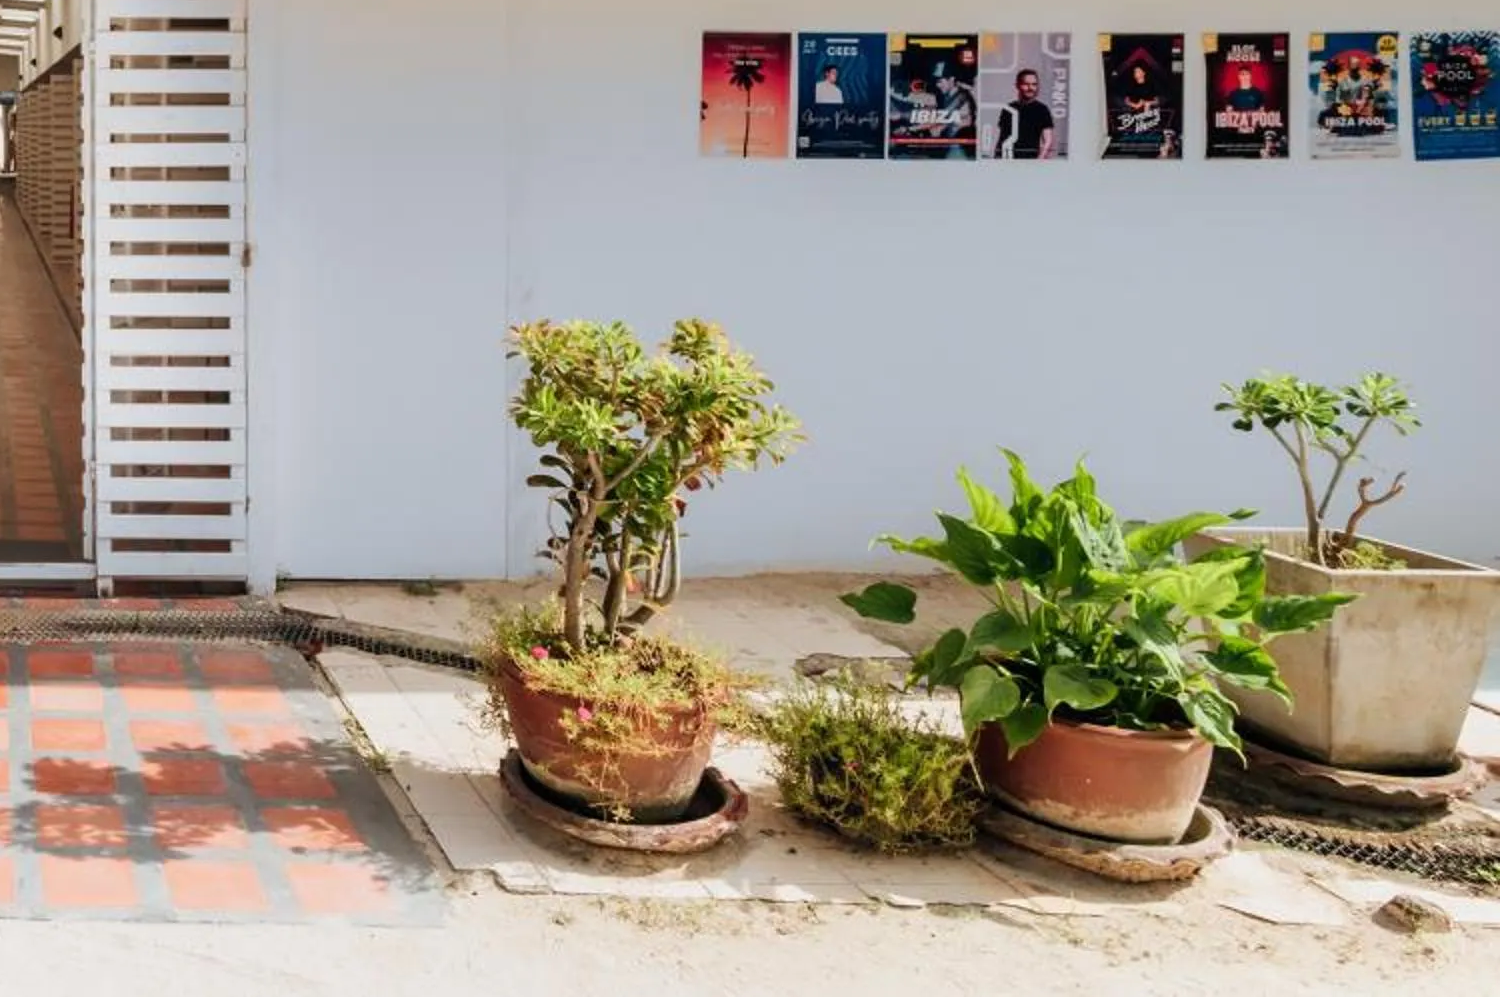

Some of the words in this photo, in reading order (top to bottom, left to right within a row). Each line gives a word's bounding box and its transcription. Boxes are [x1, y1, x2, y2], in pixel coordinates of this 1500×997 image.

[1437, 70, 1475, 82] POOL
[910, 109, 961, 124] IBIZA
[1215, 111, 1248, 128] IBIZA
[1251, 111, 1283, 128] POOL
[1325, 117, 1355, 127] IBIZA
[1358, 116, 1385, 126] POOL
